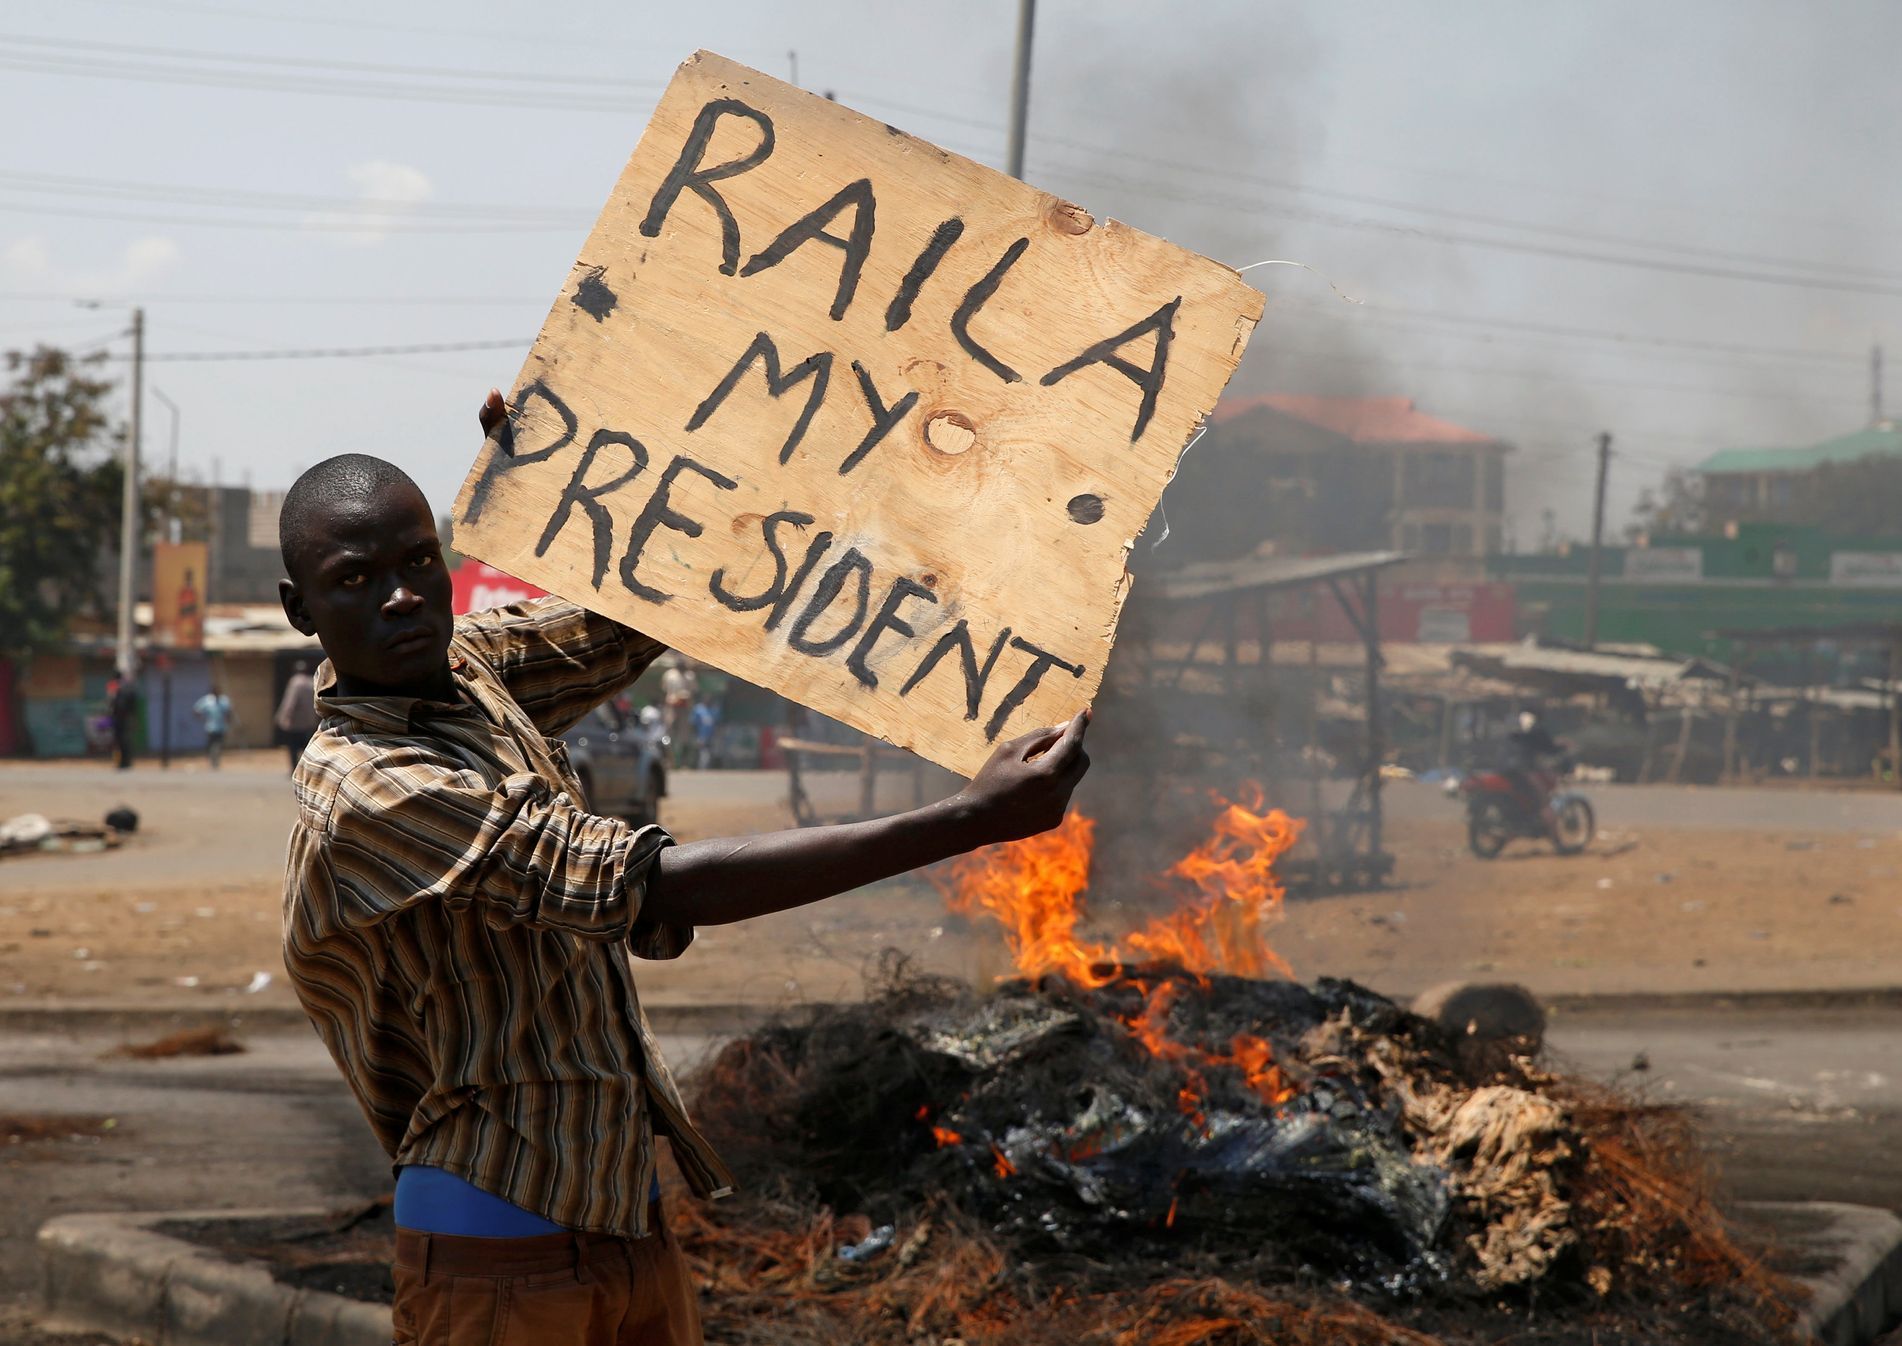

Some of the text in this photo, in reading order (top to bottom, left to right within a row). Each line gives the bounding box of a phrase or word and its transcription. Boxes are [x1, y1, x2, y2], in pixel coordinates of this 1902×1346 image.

[640, 98, 1181, 442] RAILA
[686, 332, 918, 475] MY
[463, 379, 1085, 742] PRESIDENT
